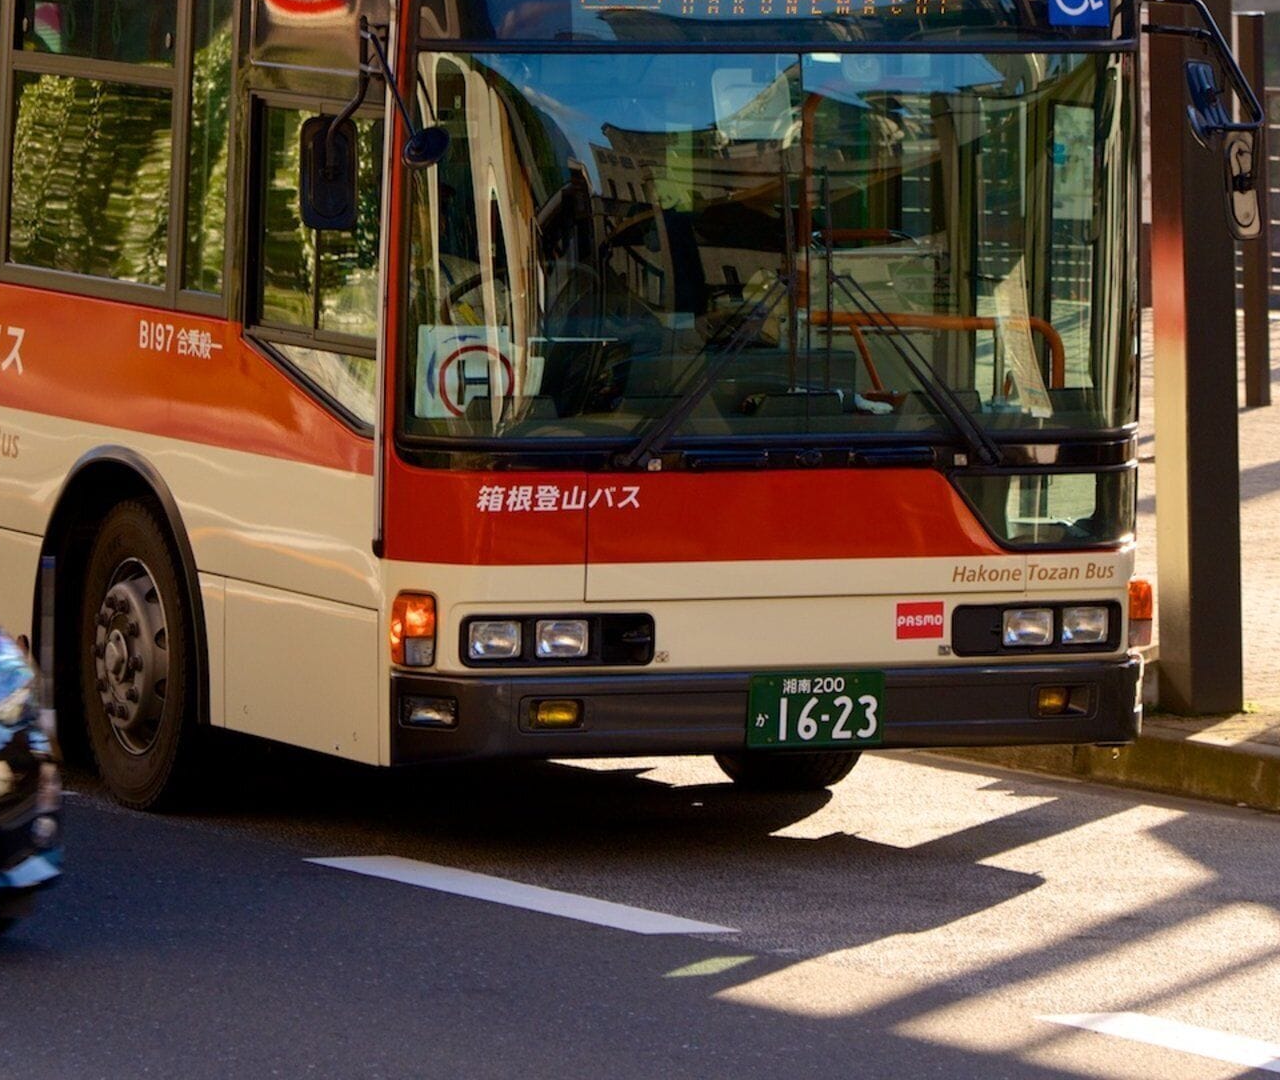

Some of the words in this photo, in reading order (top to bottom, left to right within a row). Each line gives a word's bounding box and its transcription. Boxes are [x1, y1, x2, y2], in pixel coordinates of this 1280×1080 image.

[476, 485, 641, 512] 箱根登山バス
[952, 565, 1022, 583] Hakone
[1027, 564, 1080, 581] Tozan
[1085, 562, 1114, 580] Bus
[896, 614, 943, 627] PASMO
[755, 713, 769, 728] か
[779, 694, 878, 741] 16-23
